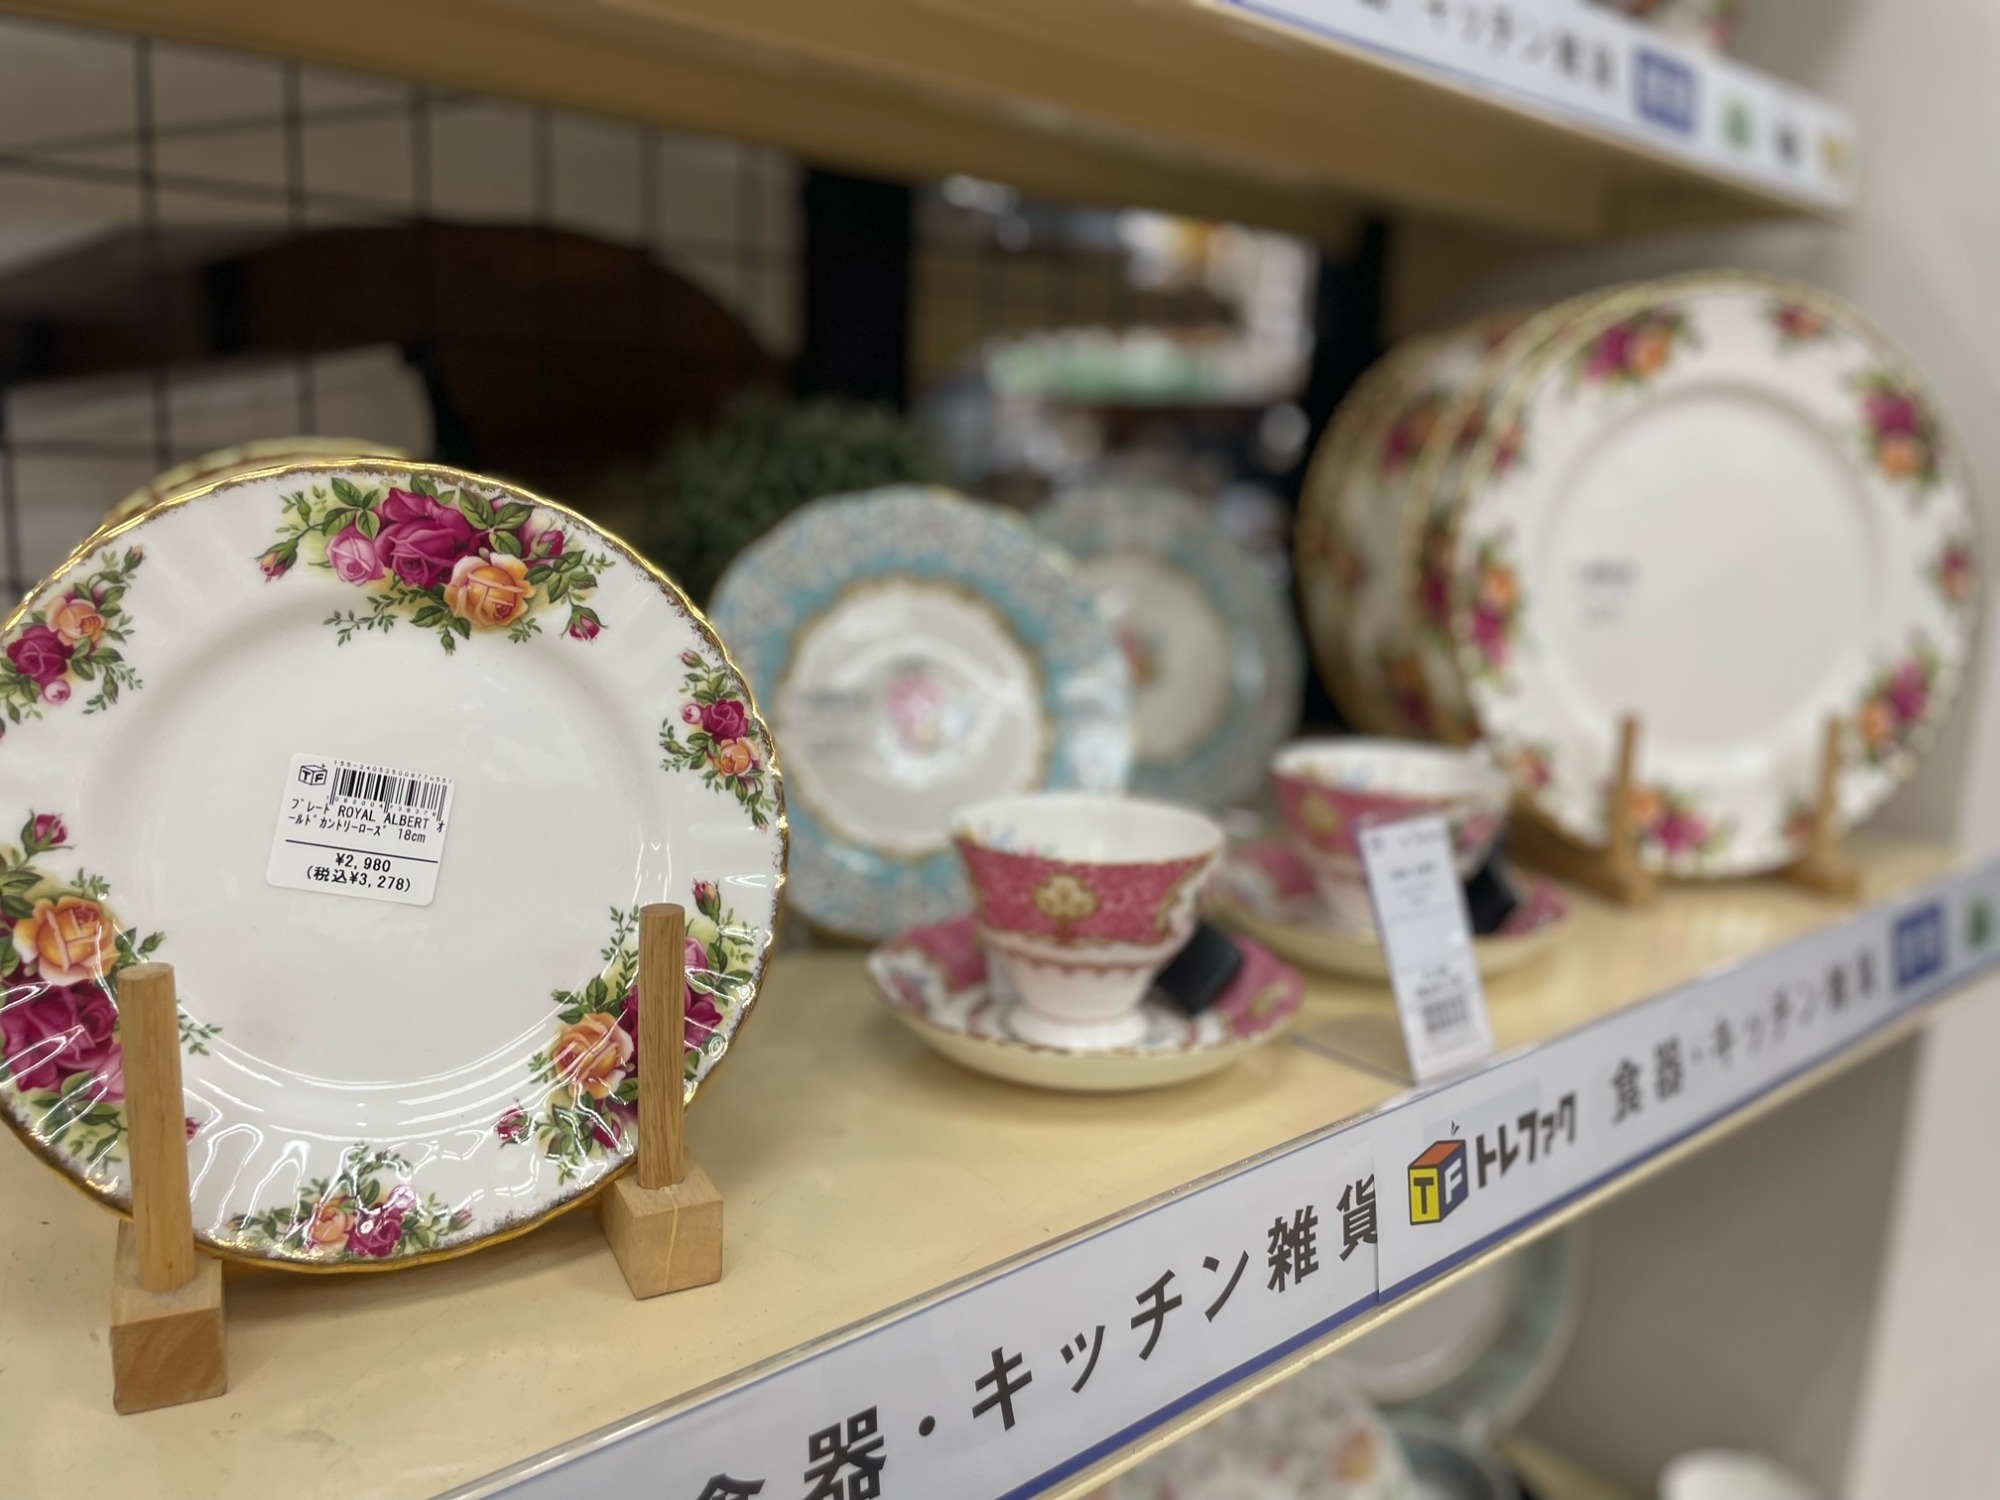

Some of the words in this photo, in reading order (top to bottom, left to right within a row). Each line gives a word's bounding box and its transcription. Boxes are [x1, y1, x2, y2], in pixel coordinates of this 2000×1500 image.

[337, 805, 376, 822] ROYAL
[383, 812, 430, 830] ALBERT
[398, 828, 426, 843] 18cm
[335, 852, 391, 872] ¥2,980
